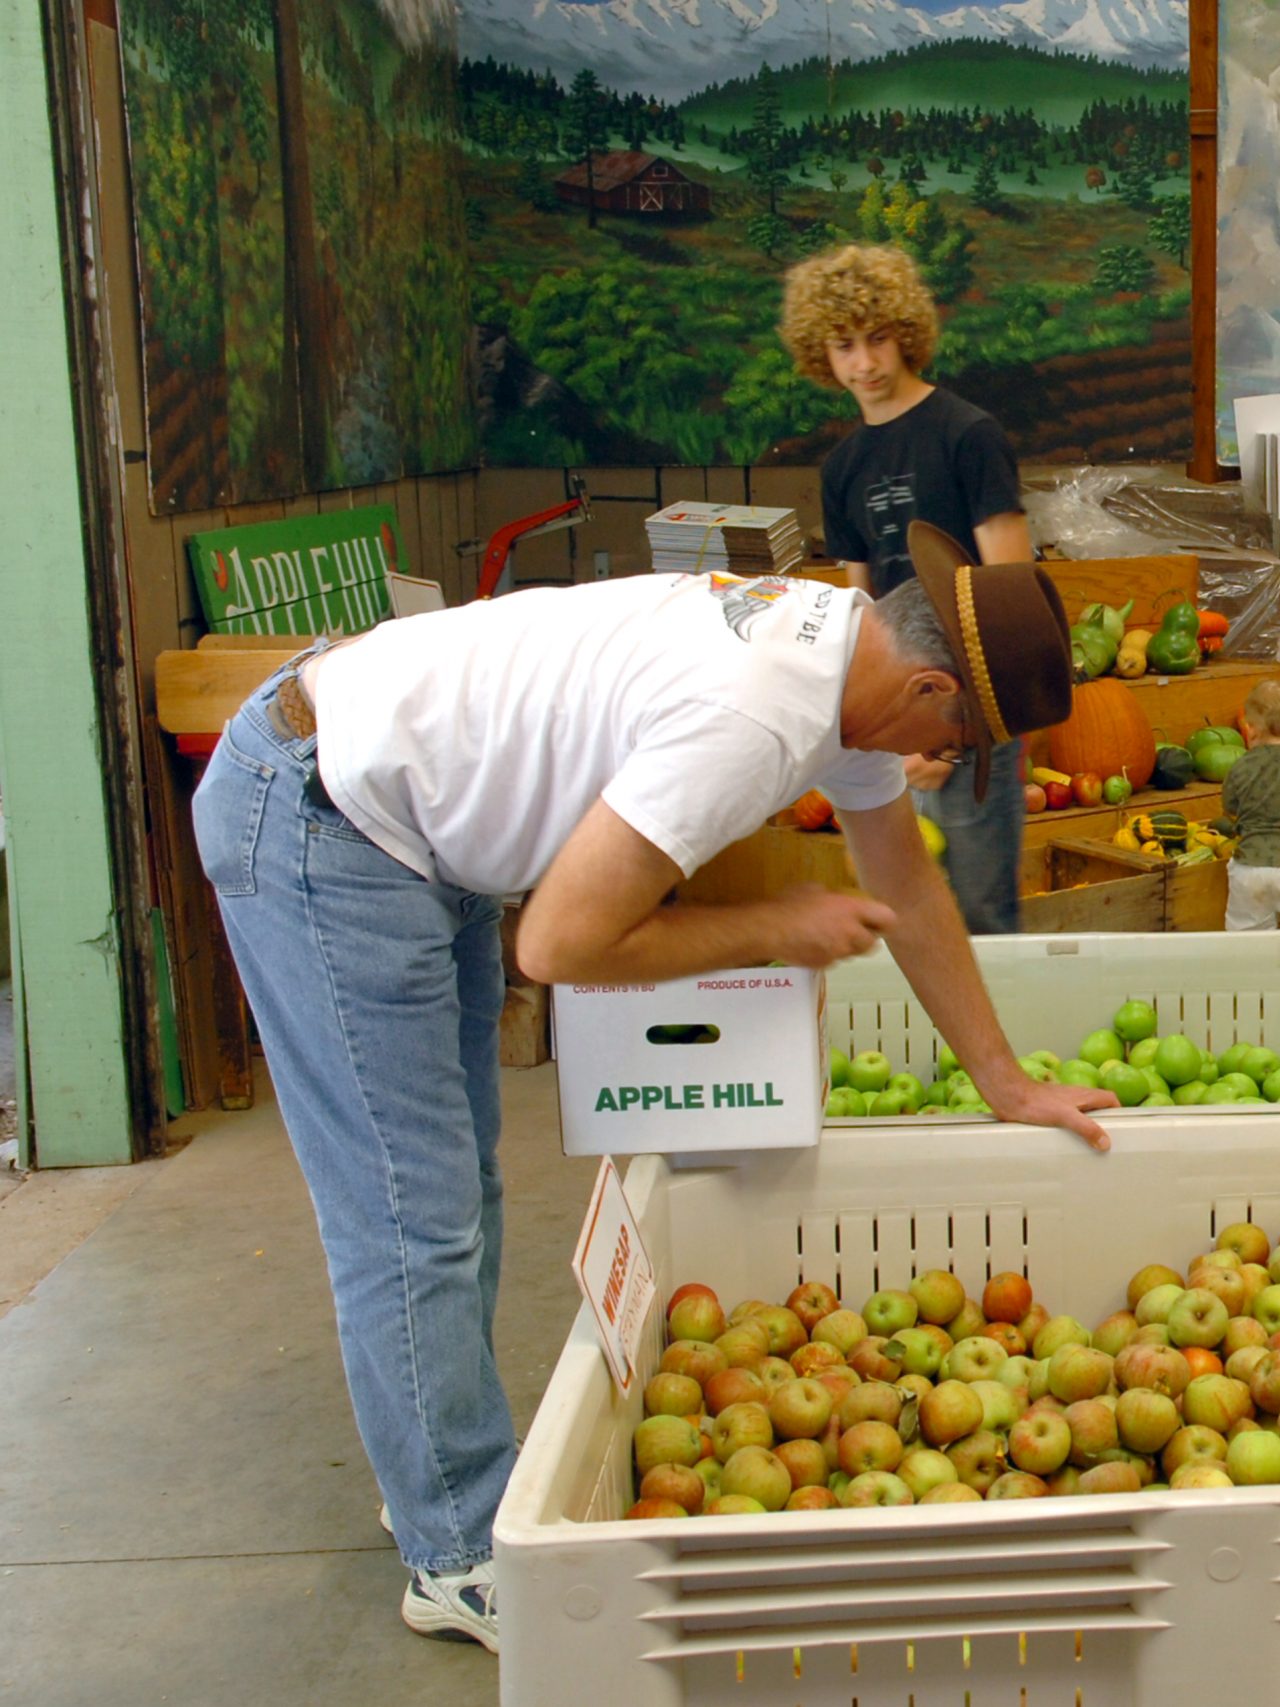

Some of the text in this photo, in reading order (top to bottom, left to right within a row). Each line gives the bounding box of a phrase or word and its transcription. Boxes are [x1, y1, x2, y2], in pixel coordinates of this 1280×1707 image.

[226, 546, 344, 636] APPLE
[697, 978, 794, 991] PRODUCE OF U.S.A.
[595, 1082, 784, 1112] APPLE HILL
[601, 1222, 631, 1327] WINESAP
